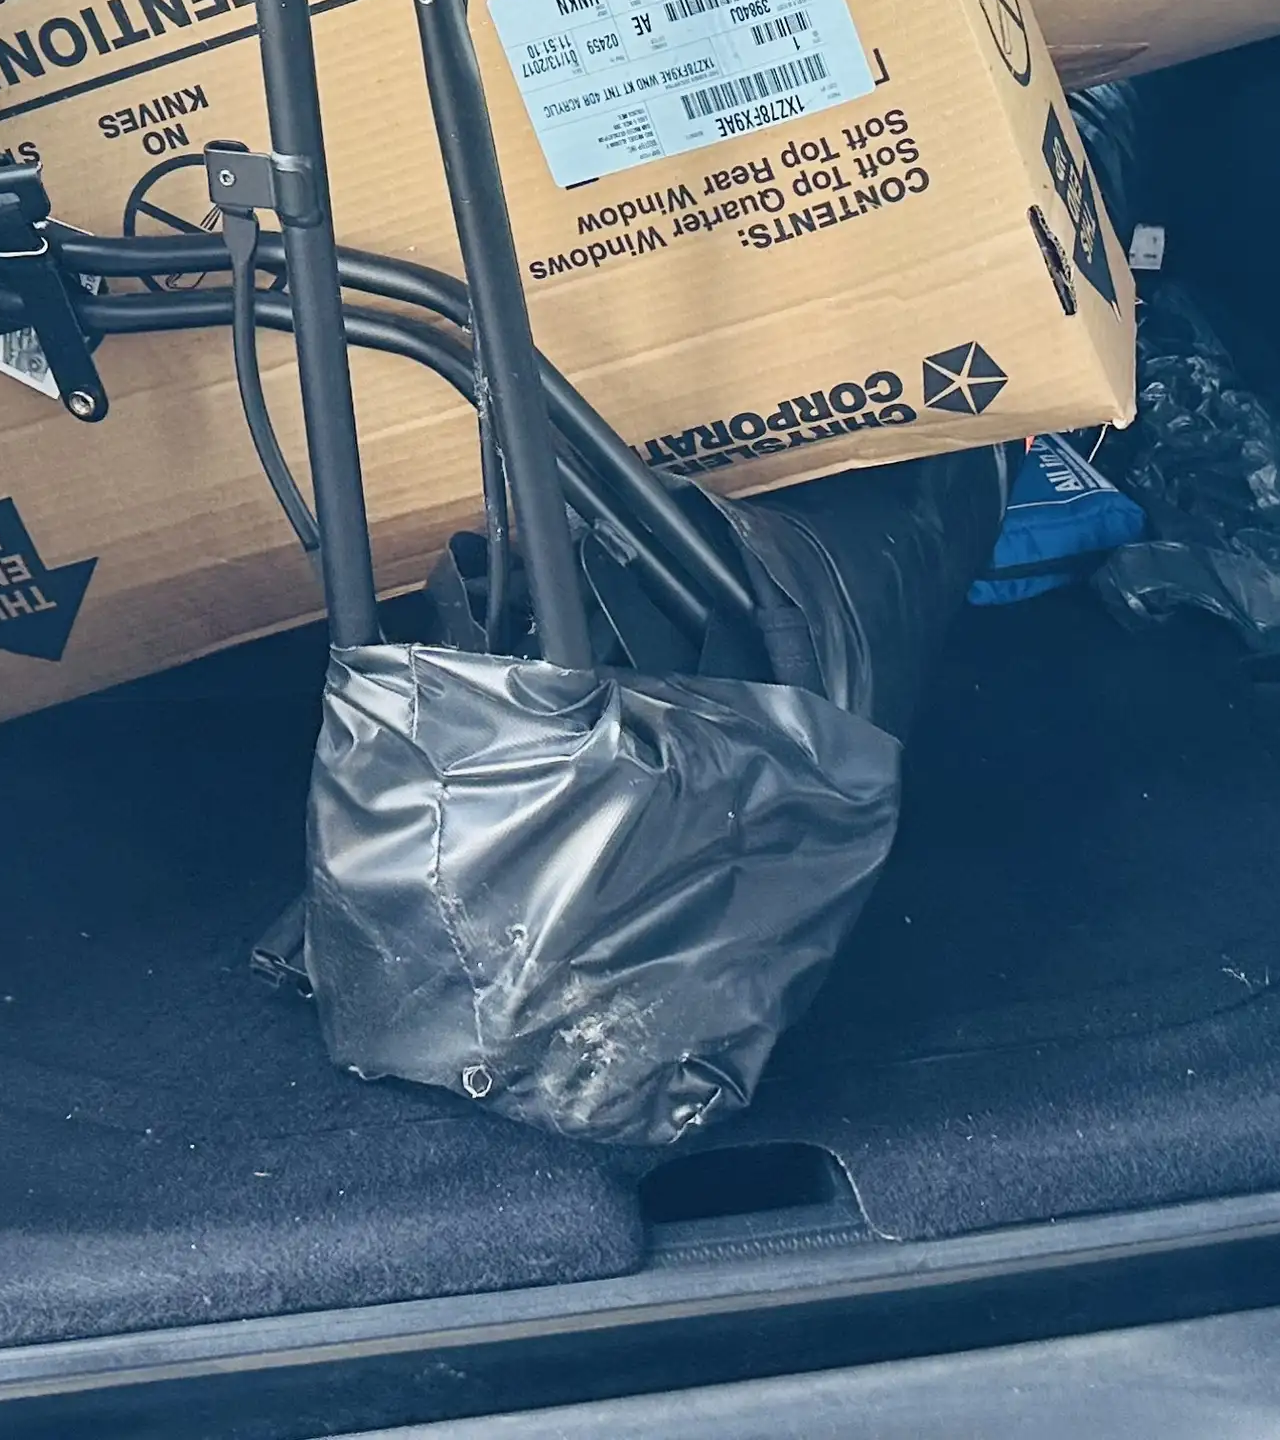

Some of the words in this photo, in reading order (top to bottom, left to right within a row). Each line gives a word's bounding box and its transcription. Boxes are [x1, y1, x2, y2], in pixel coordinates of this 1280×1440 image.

[586, 32, 619, 55] 02459
[630, 12, 652, 36] AE
[543, 97, 581, 118] ACRYLIC
[602, 85, 621, 101] TNT
[622, 80, 635, 95] KT
[97, 84, 209, 139] KNIVES
[714, 94, 805, 137] 1XZ78FX9AE
[840, 108, 908, 151] Soft
[141, 122, 190, 155] NO
[780, 136, 841, 168] Top
[852, 137, 919, 179] Soft
[703, 156, 775, 196] Rear
[791, 165, 852, 196] Top
[576, 183, 698, 235] Window
[672, 187, 785, 237] Quarter
[736, 166, 929, 249] CONTENTS:
[528, 225, 668, 279] Windows
[630, 370, 905, 467] CORPORAT
